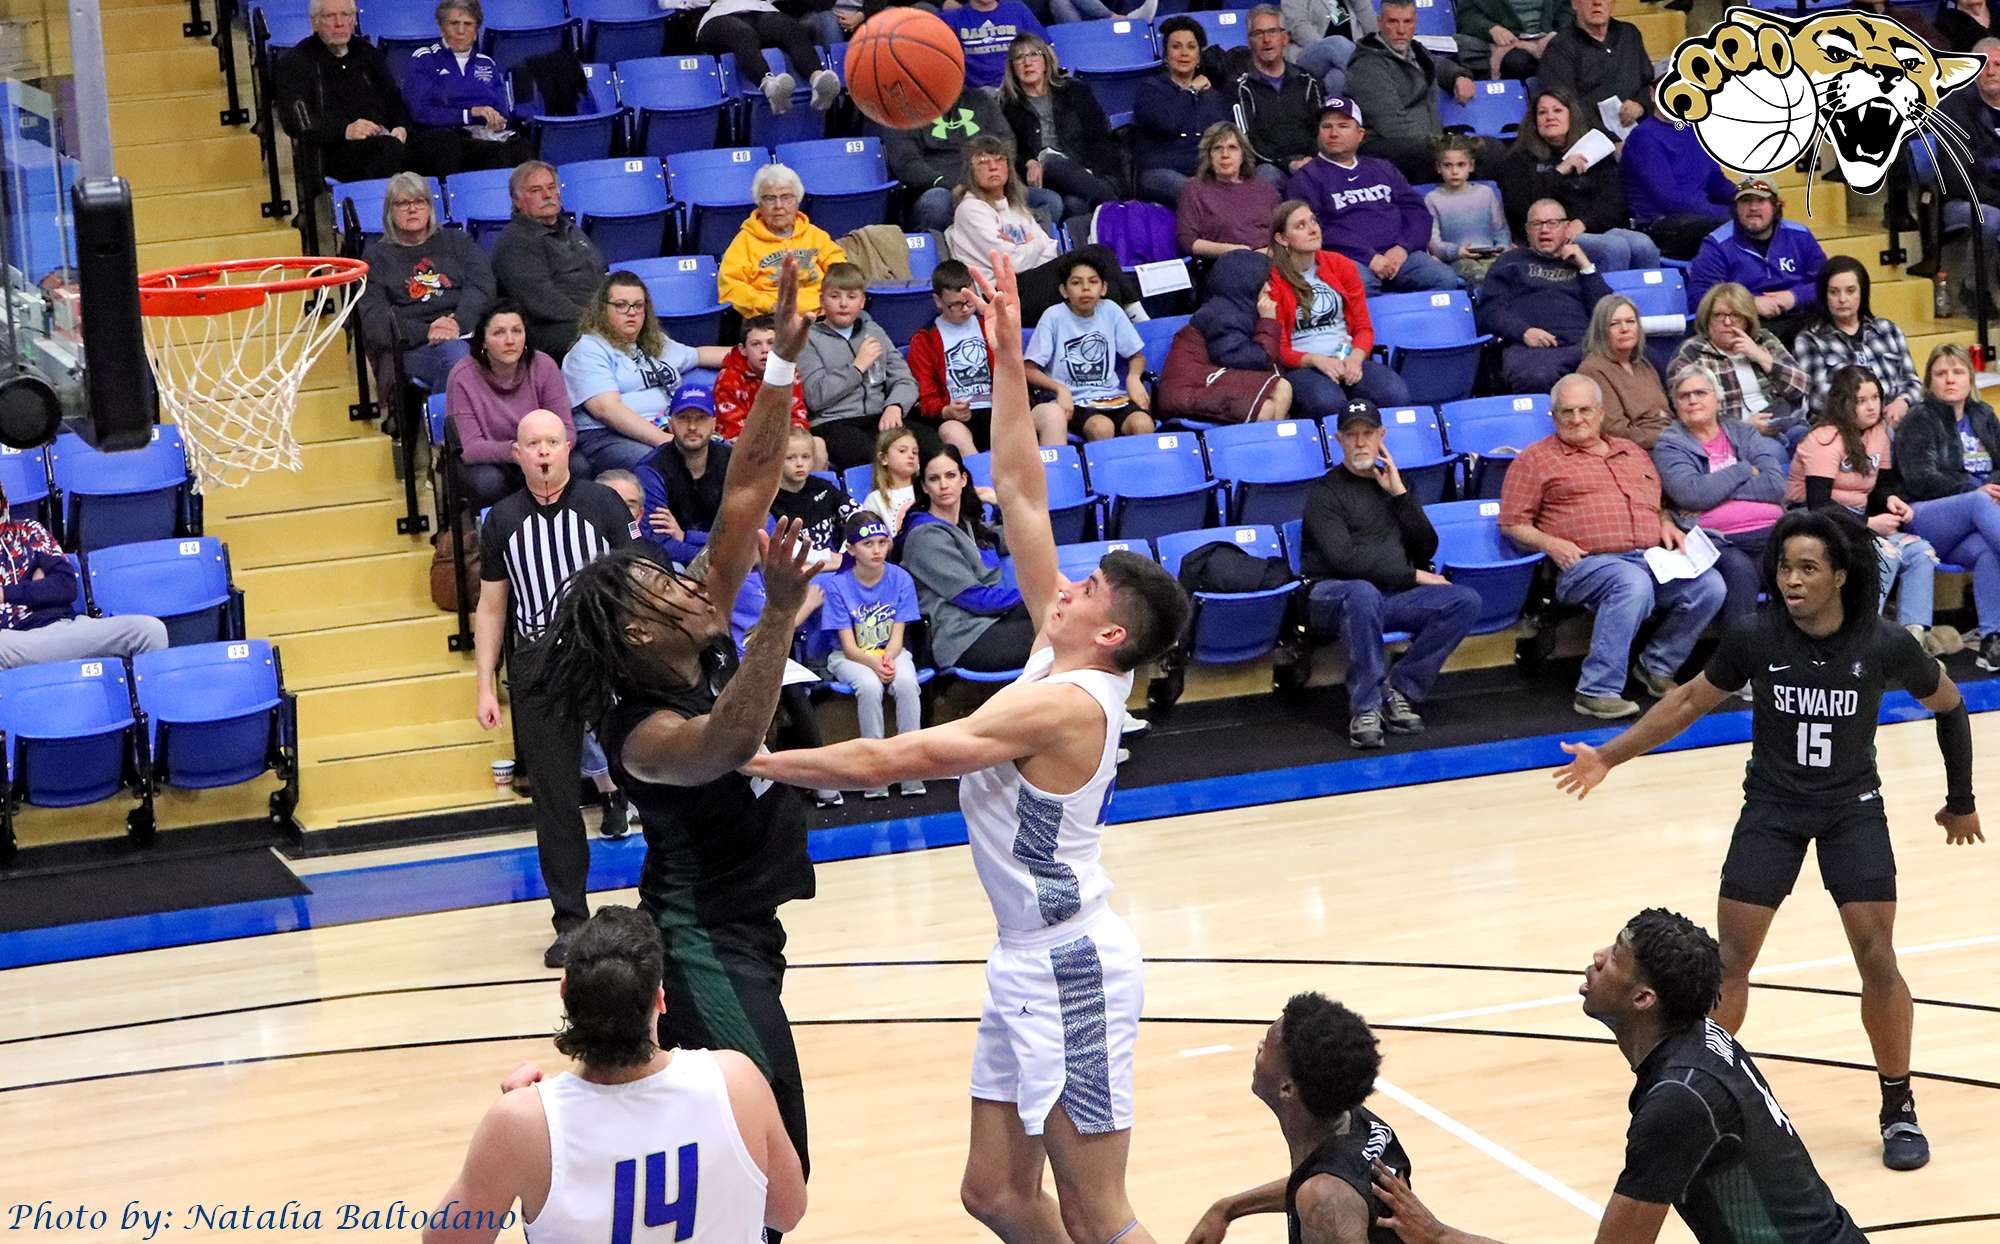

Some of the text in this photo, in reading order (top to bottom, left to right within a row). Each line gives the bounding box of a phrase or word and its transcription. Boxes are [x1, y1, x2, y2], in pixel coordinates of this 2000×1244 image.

[1331, 184, 1392, 210] K-STATE
[1773, 684, 1858, 717] SEWARD
[1796, 722, 1832, 768] 15
[611, 1141, 699, 1244] 14
